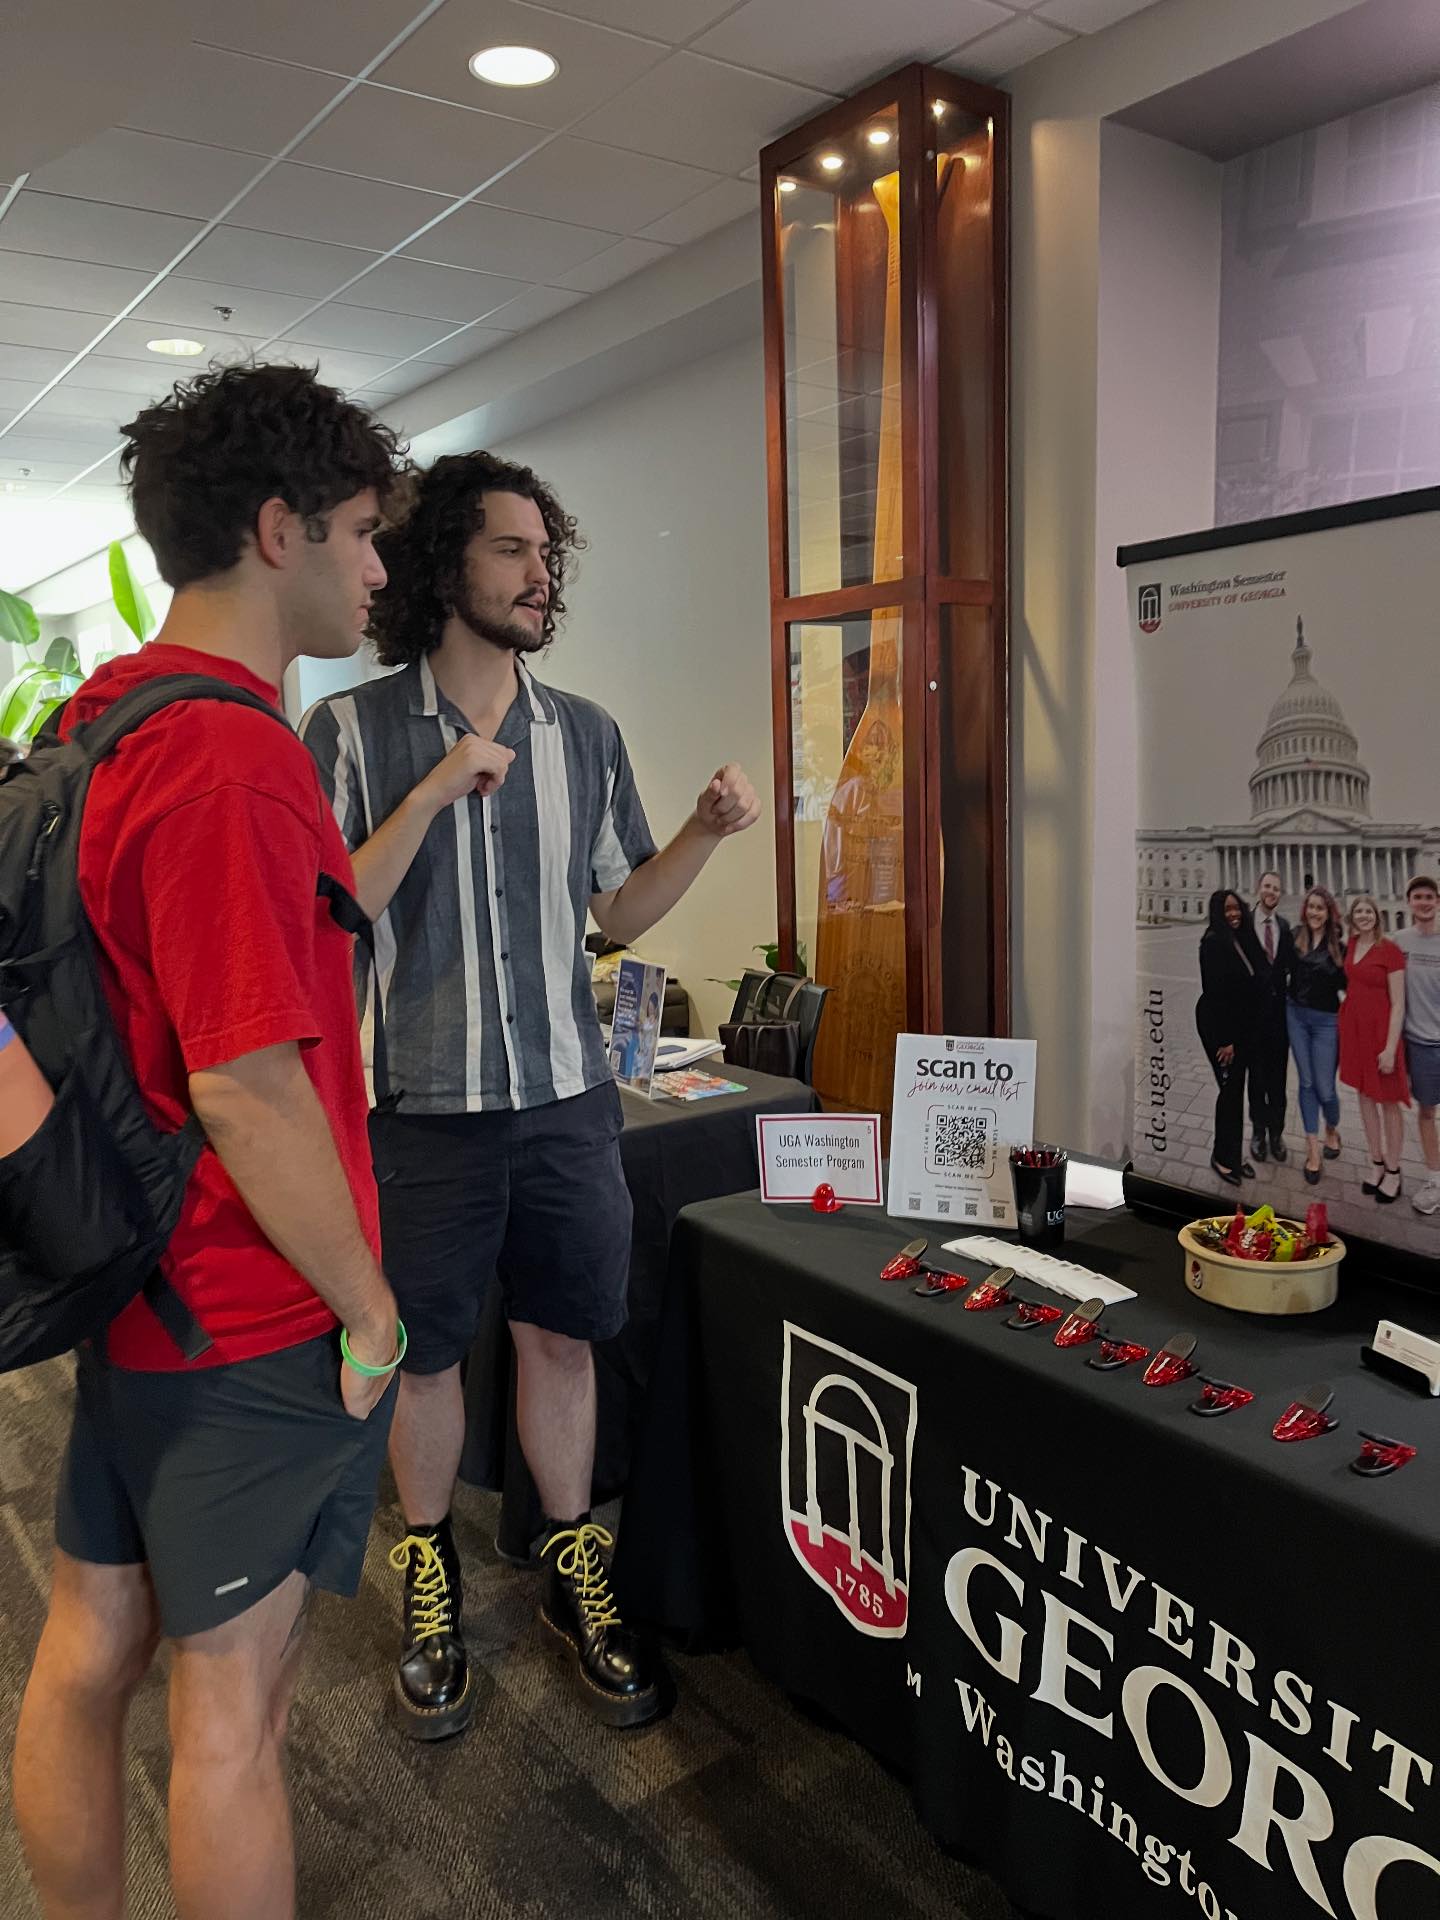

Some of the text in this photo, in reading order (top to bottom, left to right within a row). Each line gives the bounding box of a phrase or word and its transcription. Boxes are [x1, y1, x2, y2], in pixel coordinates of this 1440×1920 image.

[1170, 579, 1230, 597] Washington
[916, 1059, 1013, 1081] scan to
[1144, 990, 1171, 1152] dc.uga.edu
[907, 1079, 1028, 1101] join our email list
[867, 1125, 872, 1135] 5
[779, 1133, 860, 1150] UGA Washington
[775, 1154, 865, 1171] Semester Program
[834, 1565, 884, 1619] 1785
[961, 1465, 1433, 1813] UNIVERSIT
[955, 1678, 1238, 1920] Washingto
